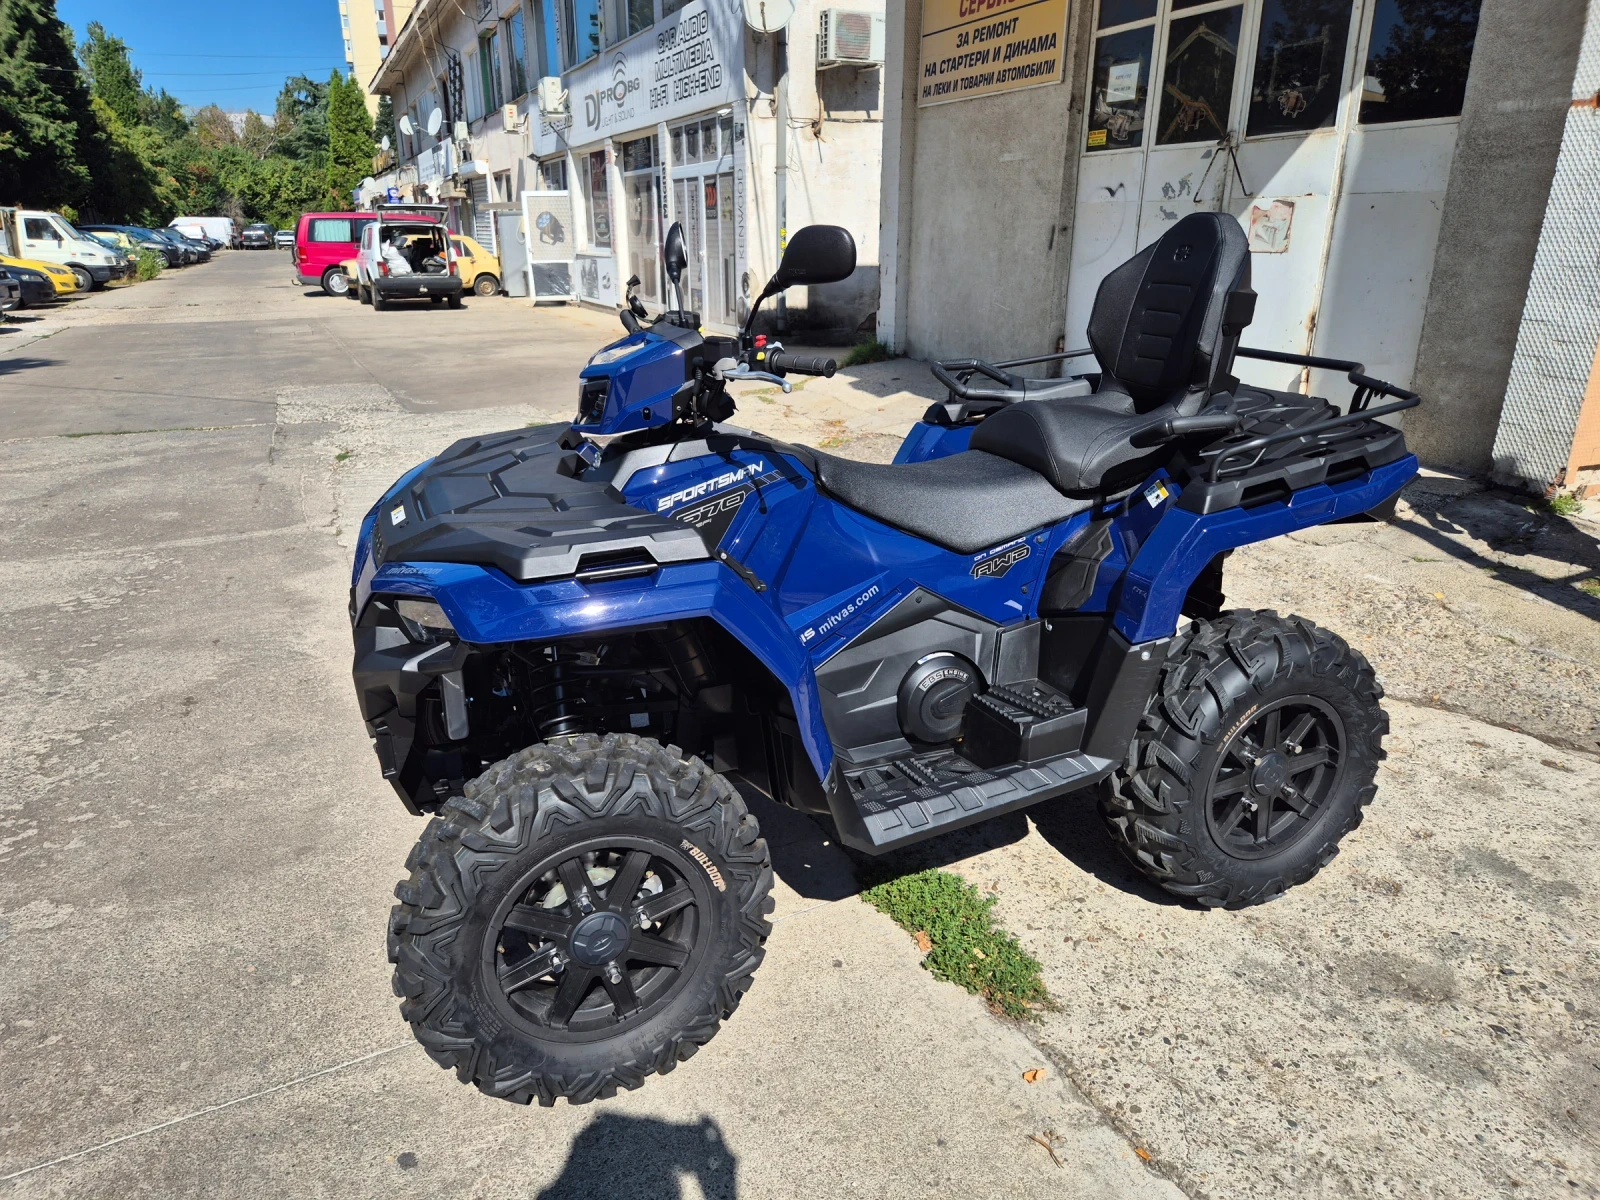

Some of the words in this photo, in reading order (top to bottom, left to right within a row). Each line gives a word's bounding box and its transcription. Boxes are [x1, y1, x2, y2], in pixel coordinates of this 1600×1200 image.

[657, 26, 678, 54] CAR
[675, 10, 709, 46] AUDIO
[956, 32, 970, 49] ЗА
[972, 17, 1020, 45] РЕМОНТ
[655, 38, 715, 82] MULTIMEDIA
[924, 61, 937, 78] НА
[939, 50, 991, 75] СТАРТЕРИ
[992, 46, 1001, 63] И
[1002, 32, 1057, 64] ДИНАМА
[673, 63, 723, 102] HIGH-END
[922, 85, 933, 99] НА
[932, 80, 952, 97] ЛЕКИ
[952, 78, 959, 93] И
[960, 71, 995, 91] ТОВАРНИ
[996, 58, 1057, 84] АВТОМОБИЛИ
[657, 460, 764, 512] SPORTSMAN
[974, 545, 1031, 580] AWD
[818, 585, 880, 635] mitvas.com
[1222, 704, 1259, 743] BULLDOG
[689, 845, 727, 890] BULLDOG
